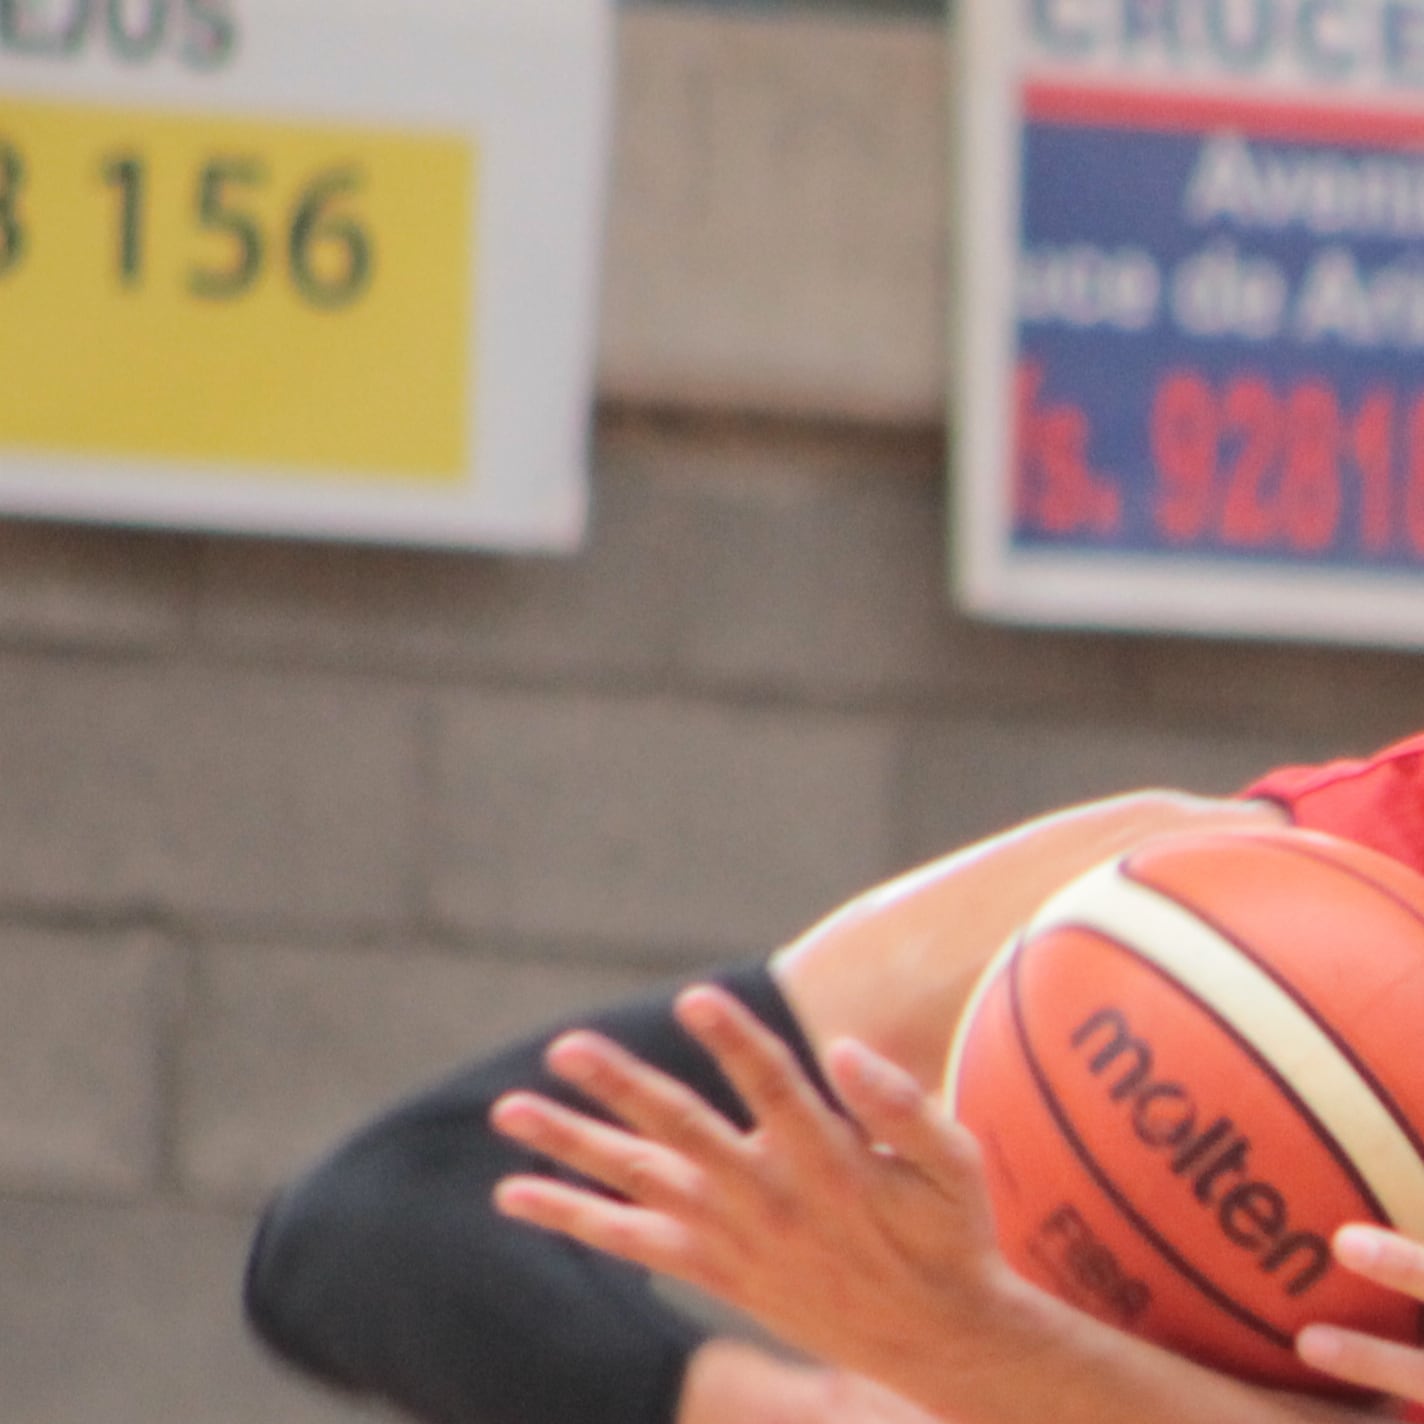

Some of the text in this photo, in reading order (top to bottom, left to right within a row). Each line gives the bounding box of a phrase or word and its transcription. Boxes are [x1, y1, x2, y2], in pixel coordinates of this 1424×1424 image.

[96, 143, 378, 315] 156
[1170, 233, 1290, 342] de
[1070, 1005, 1337, 1298] molten
